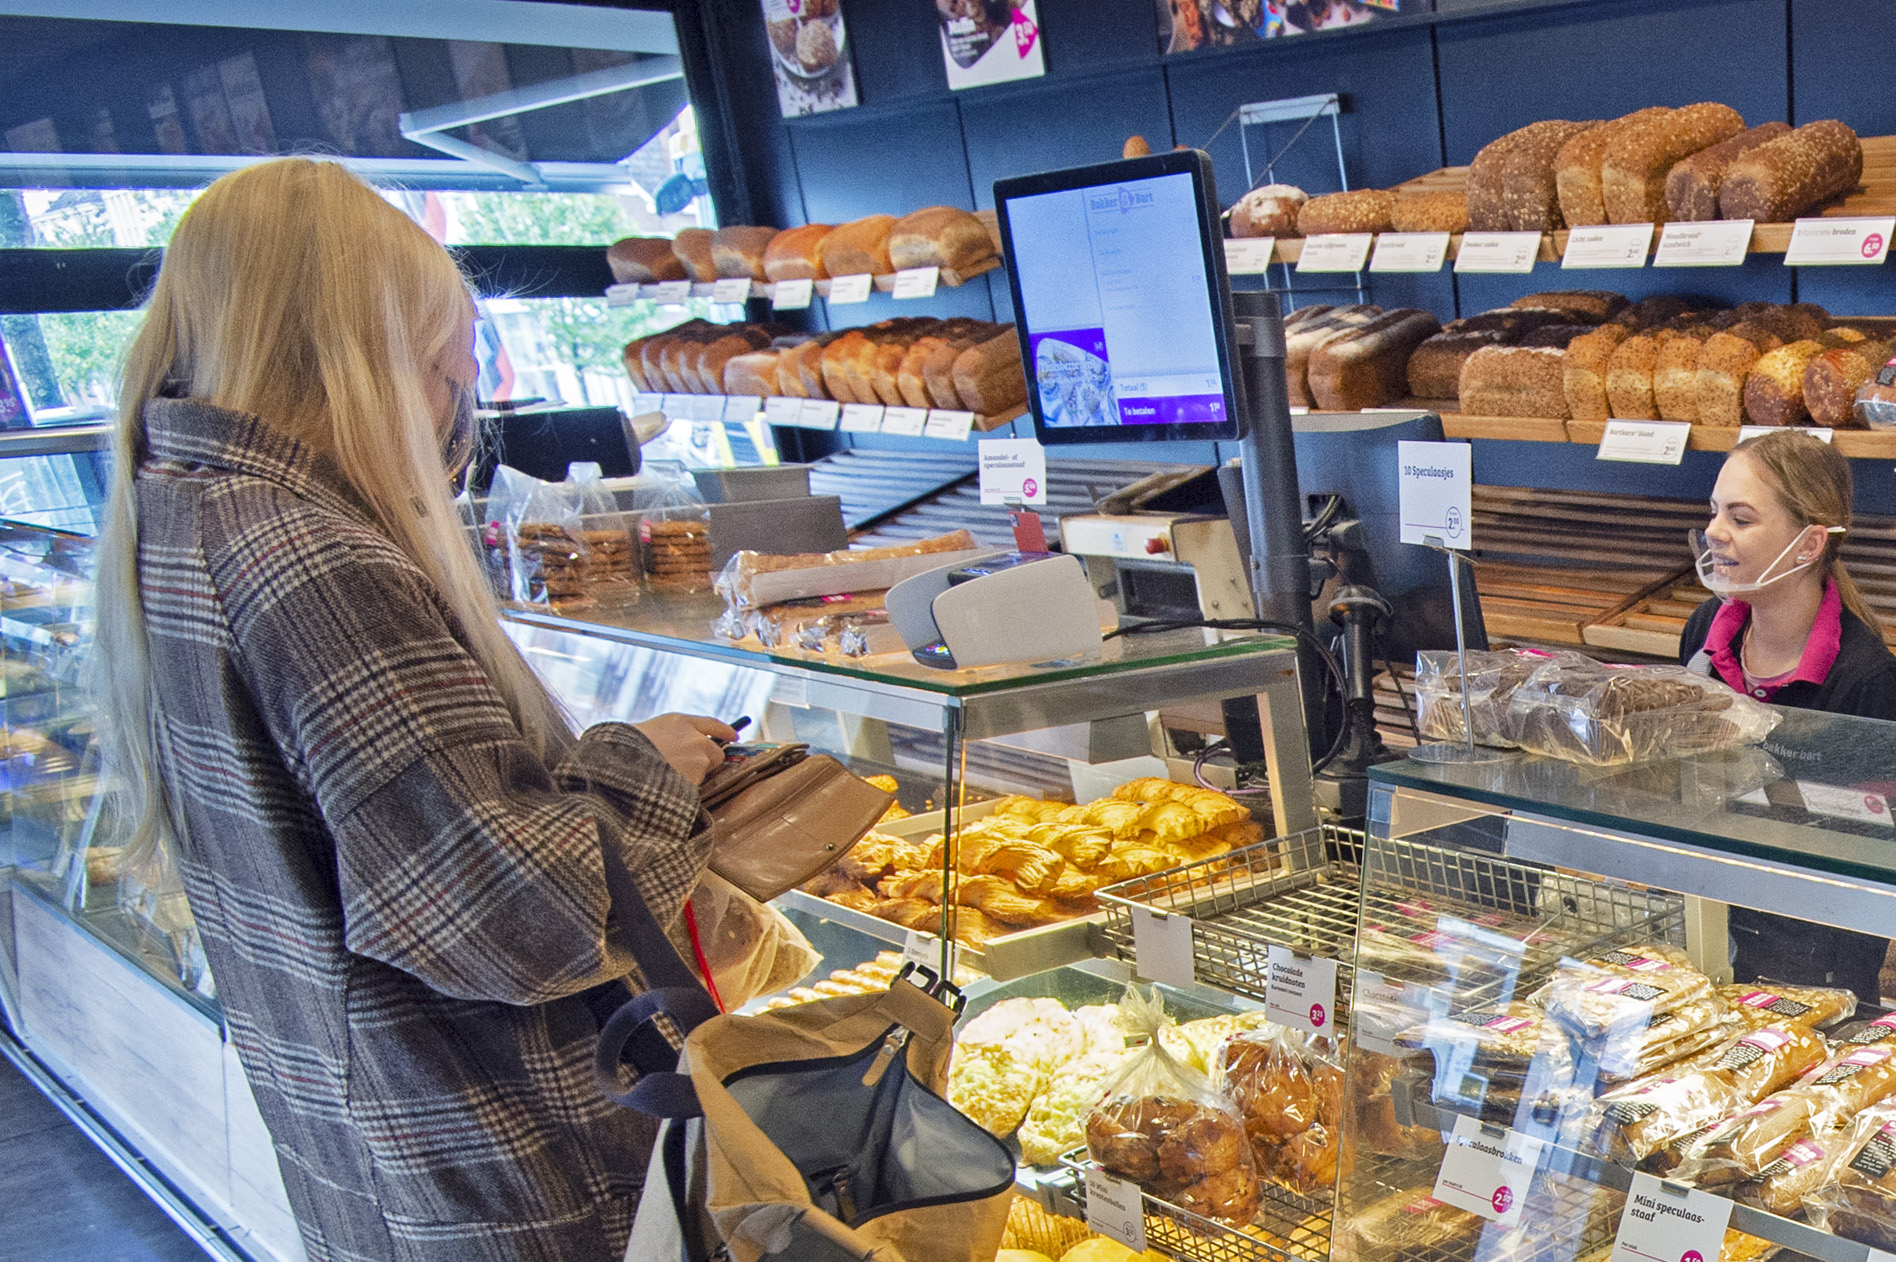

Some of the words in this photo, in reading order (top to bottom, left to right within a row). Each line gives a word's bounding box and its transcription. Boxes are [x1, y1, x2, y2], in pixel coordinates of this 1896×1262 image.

[1412, 465, 1454, 480] Speculaasjes
[1762, 741, 1798, 758] bakker
[1799, 751, 1822, 761] bart
[1272, 962, 1304, 977] Chocolade
[1271, 972, 1306, 989] kruidnoten
[1630, 1207, 1656, 1222] staaf
[1633, 1194, 1656, 1209] Mini
[1656, 1201, 1705, 1224] speculaas-
